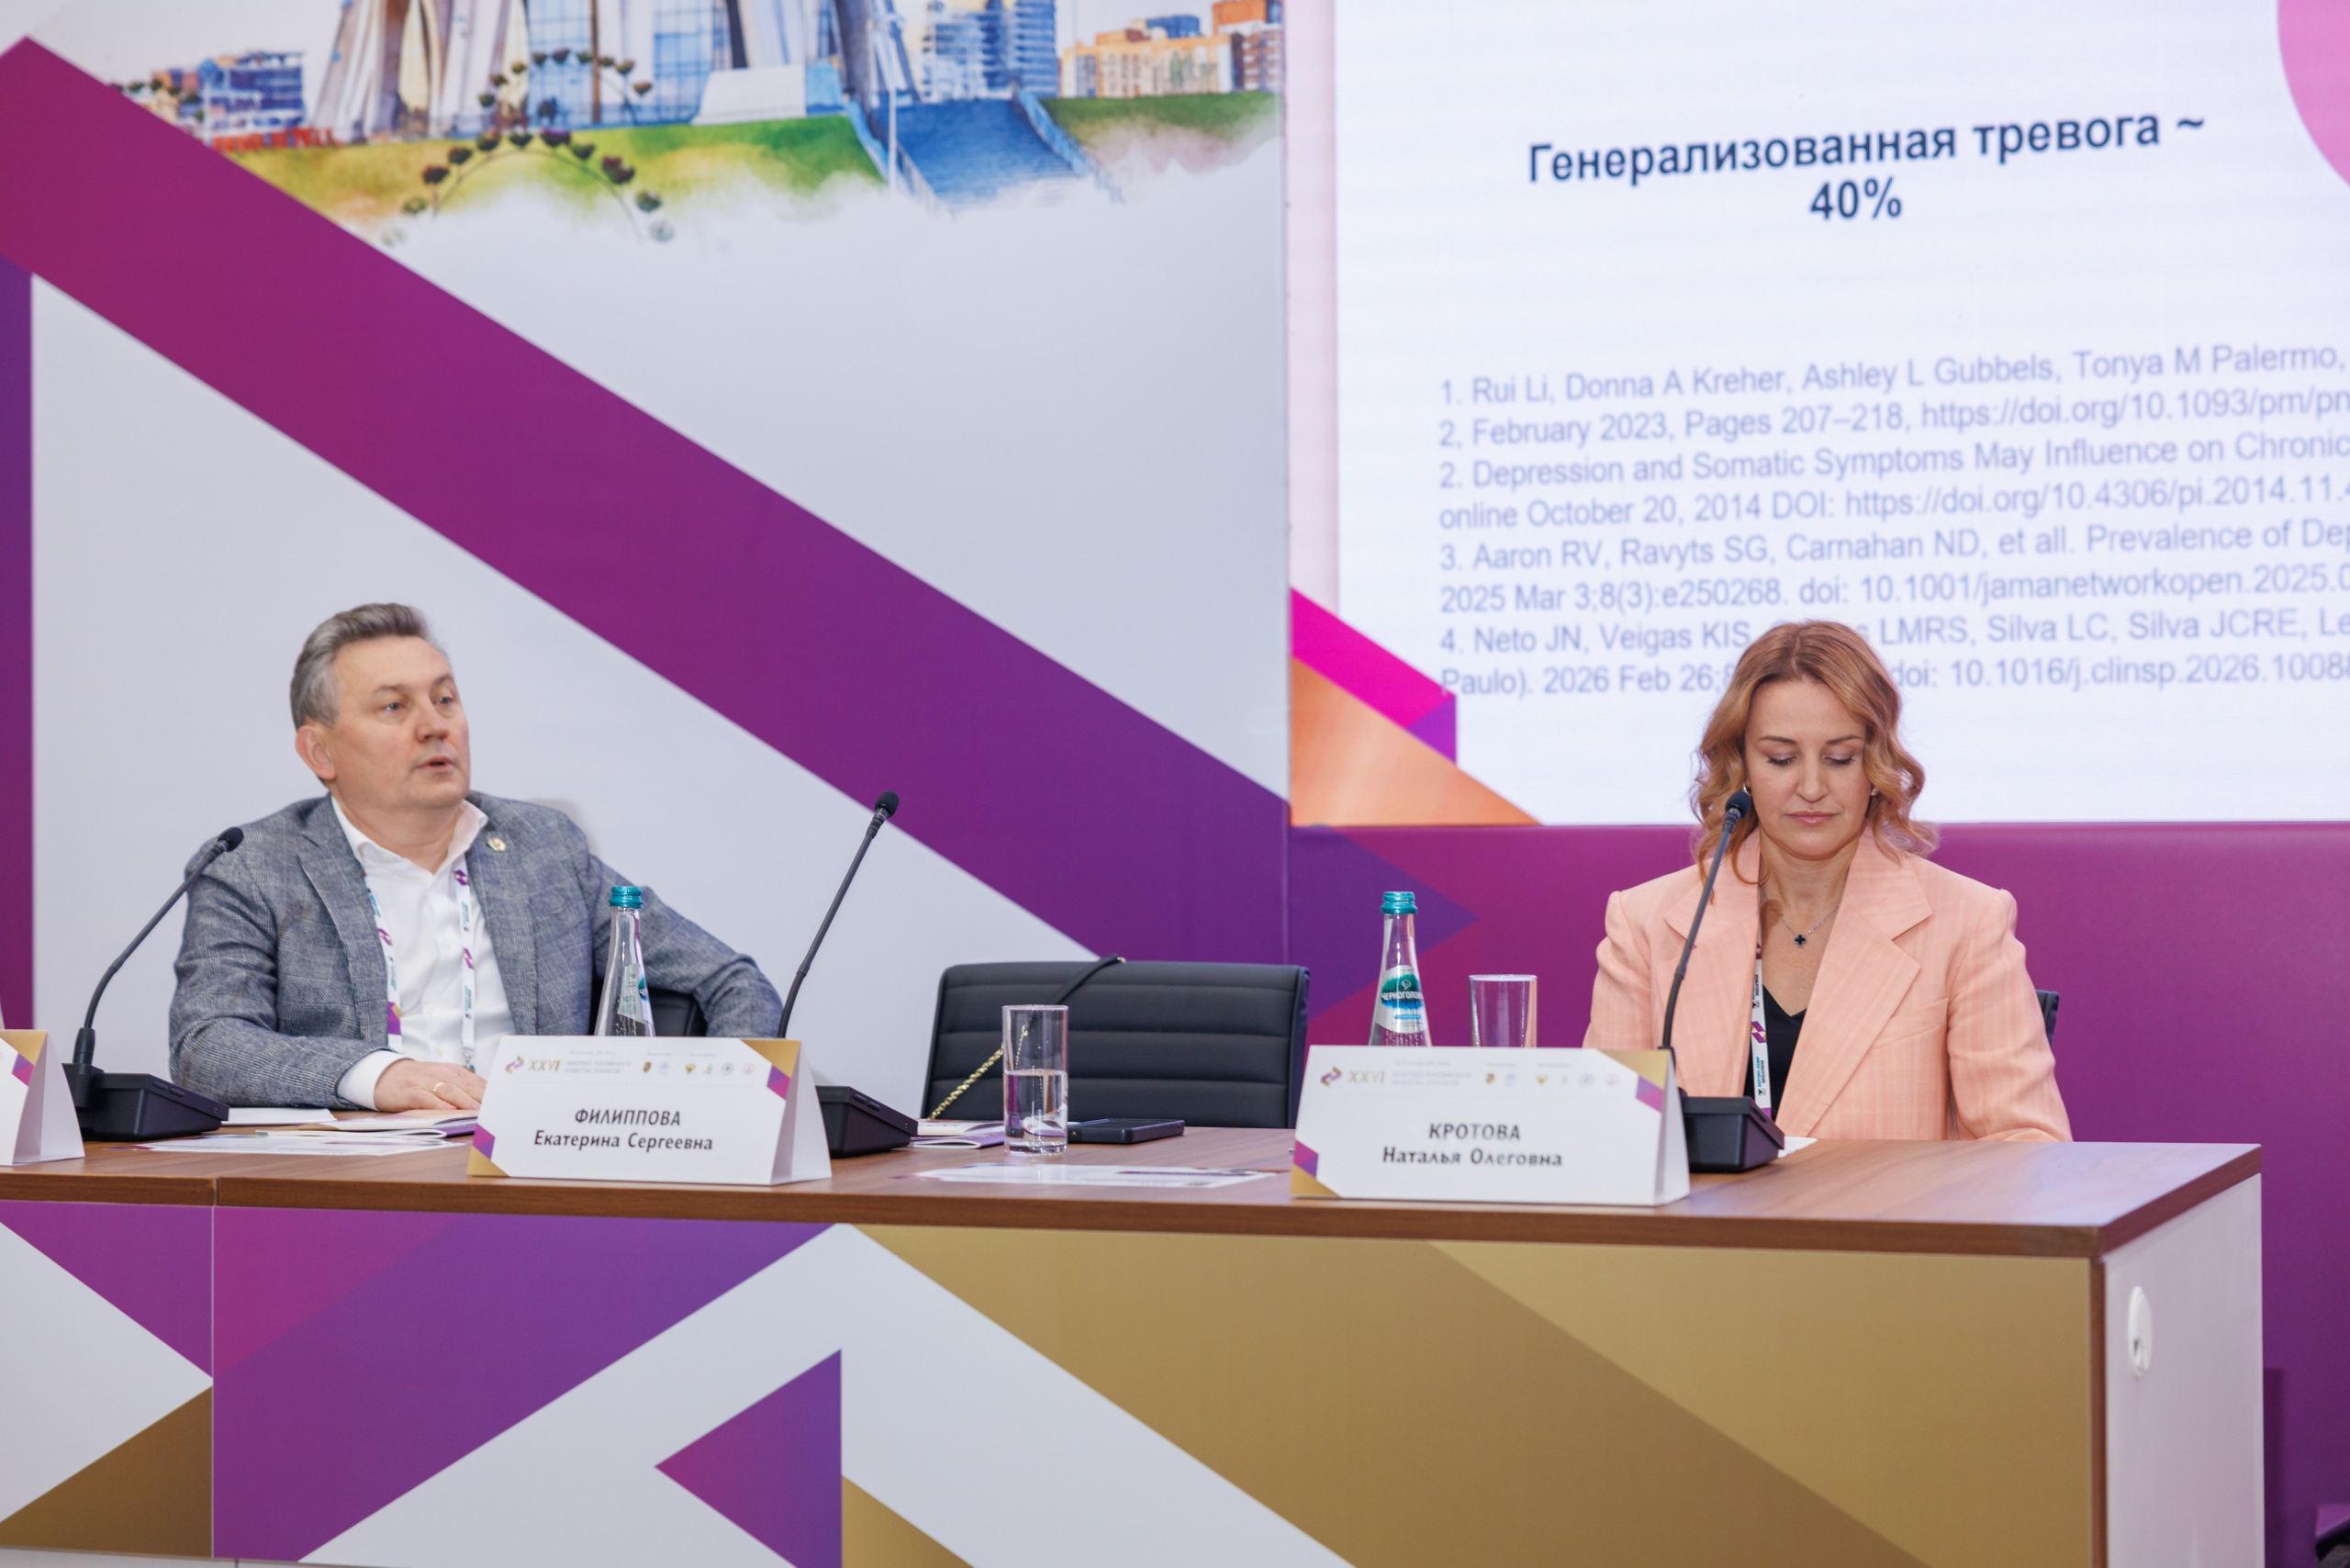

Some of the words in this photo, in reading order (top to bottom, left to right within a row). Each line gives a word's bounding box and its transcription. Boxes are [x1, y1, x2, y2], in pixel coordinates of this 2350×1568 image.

[1528, 129, 1956, 186] Генерализованная
[1973, 114, 2160, 165] тревога
[1809, 176, 1903, 221] 40%
[1441, 380, 1461, 405] 1.
[1472, 377, 1515, 404] Rui
[1526, 375, 1555, 406] Li,
[1566, 372, 1653, 401] Donna
[1664, 370, 1684, 397] A
[1694, 366, 1792, 396] Kreher,
[1802, 363, 1897, 393] Ashley
[1908, 360, 1923, 386] L
[1935, 353, 2061, 385] Gubbels,
[2074, 350, 2164, 384] Tonya
[2176, 346, 2200, 375] M
[2212, 343, 2345, 373] Palermo,
[1440, 420, 1462, 449] 2,
[1472, 418, 1591, 448] February
[1601, 412, 1675, 442] 2023,
[1685, 409, 1772, 442] Pages
[1440, 461, 1461, 488] 2.
[1473, 457, 1624, 492] Depression
[1634, 454, 1683, 482] and
[1693, 450, 1805, 480] Somatic
[1814, 445, 1964, 481] Symptoms
[1975, 441, 2034, 475] May
[2046, 438, 2177, 467] Influence
[2188, 438, 2224, 463] on
[2235, 429, 2350, 462] Chronic
[1439, 500, 1518, 530] online
[1528, 498, 1634, 528] October
[1643, 496, 1684, 526] 20,
[1695, 493, 1761, 522] 2014
[1773, 490, 1835, 520] DOI:
[1846, 474, 2350, 520] https://doi.org/10.4306/pi.2014.11.
[1441, 543, 1462, 571] 3.
[1472, 543, 1551, 571] Aaron
[1562, 540, 1610, 569] RV,
[1621, 538, 1714, 571] Ravyts
[1724, 535, 1776, 565] SG,
[1786, 528, 1923, 561] Carnahan
[1935, 529, 1988, 560] ND,
[1998, 531, 2025, 554] et
[2035, 526, 2074, 554] all.
[2087, 523, 2252, 552] Prevalence
[2263, 520, 2290, 548] of
[2302, 518, 2350, 553] De
[1441, 585, 1505, 612] 2025
[1516, 584, 1565, 611] Mar
[1799, 576, 1848, 604] doi:
[1441, 628, 1462, 655] 4.
[1474, 626, 1537, 655] Neto
[1545, 624, 1590, 655] JN,
[1600, 622, 1692, 656] Veigas
[1881, 616, 1975, 645] LMRS,
[1987, 612, 2056, 643] Silva
[2068, 611, 2116, 643] LC,
[2129, 609, 2199, 639] Silva
[2210, 608, 2307, 640] JCRE,
[1441, 667, 1533, 700] Paulo).
[1543, 666, 1609, 693] 2026
[1620, 664, 1671, 691] Feb
[1893, 659, 1937, 687] doi:
[527, 1059, 561, 1072] XXVI
[575, 1109, 681, 1126] ФИЛИППОВА
[1428, 1124, 1520, 1140] КРОТОВА
[534, 1130, 620, 1150] Екатерина
[628, 1133, 713, 1152] Сергеевна
[1382, 1147, 1461, 1164] Наталья
[1471, 1149, 1562, 1167] Олеговна
